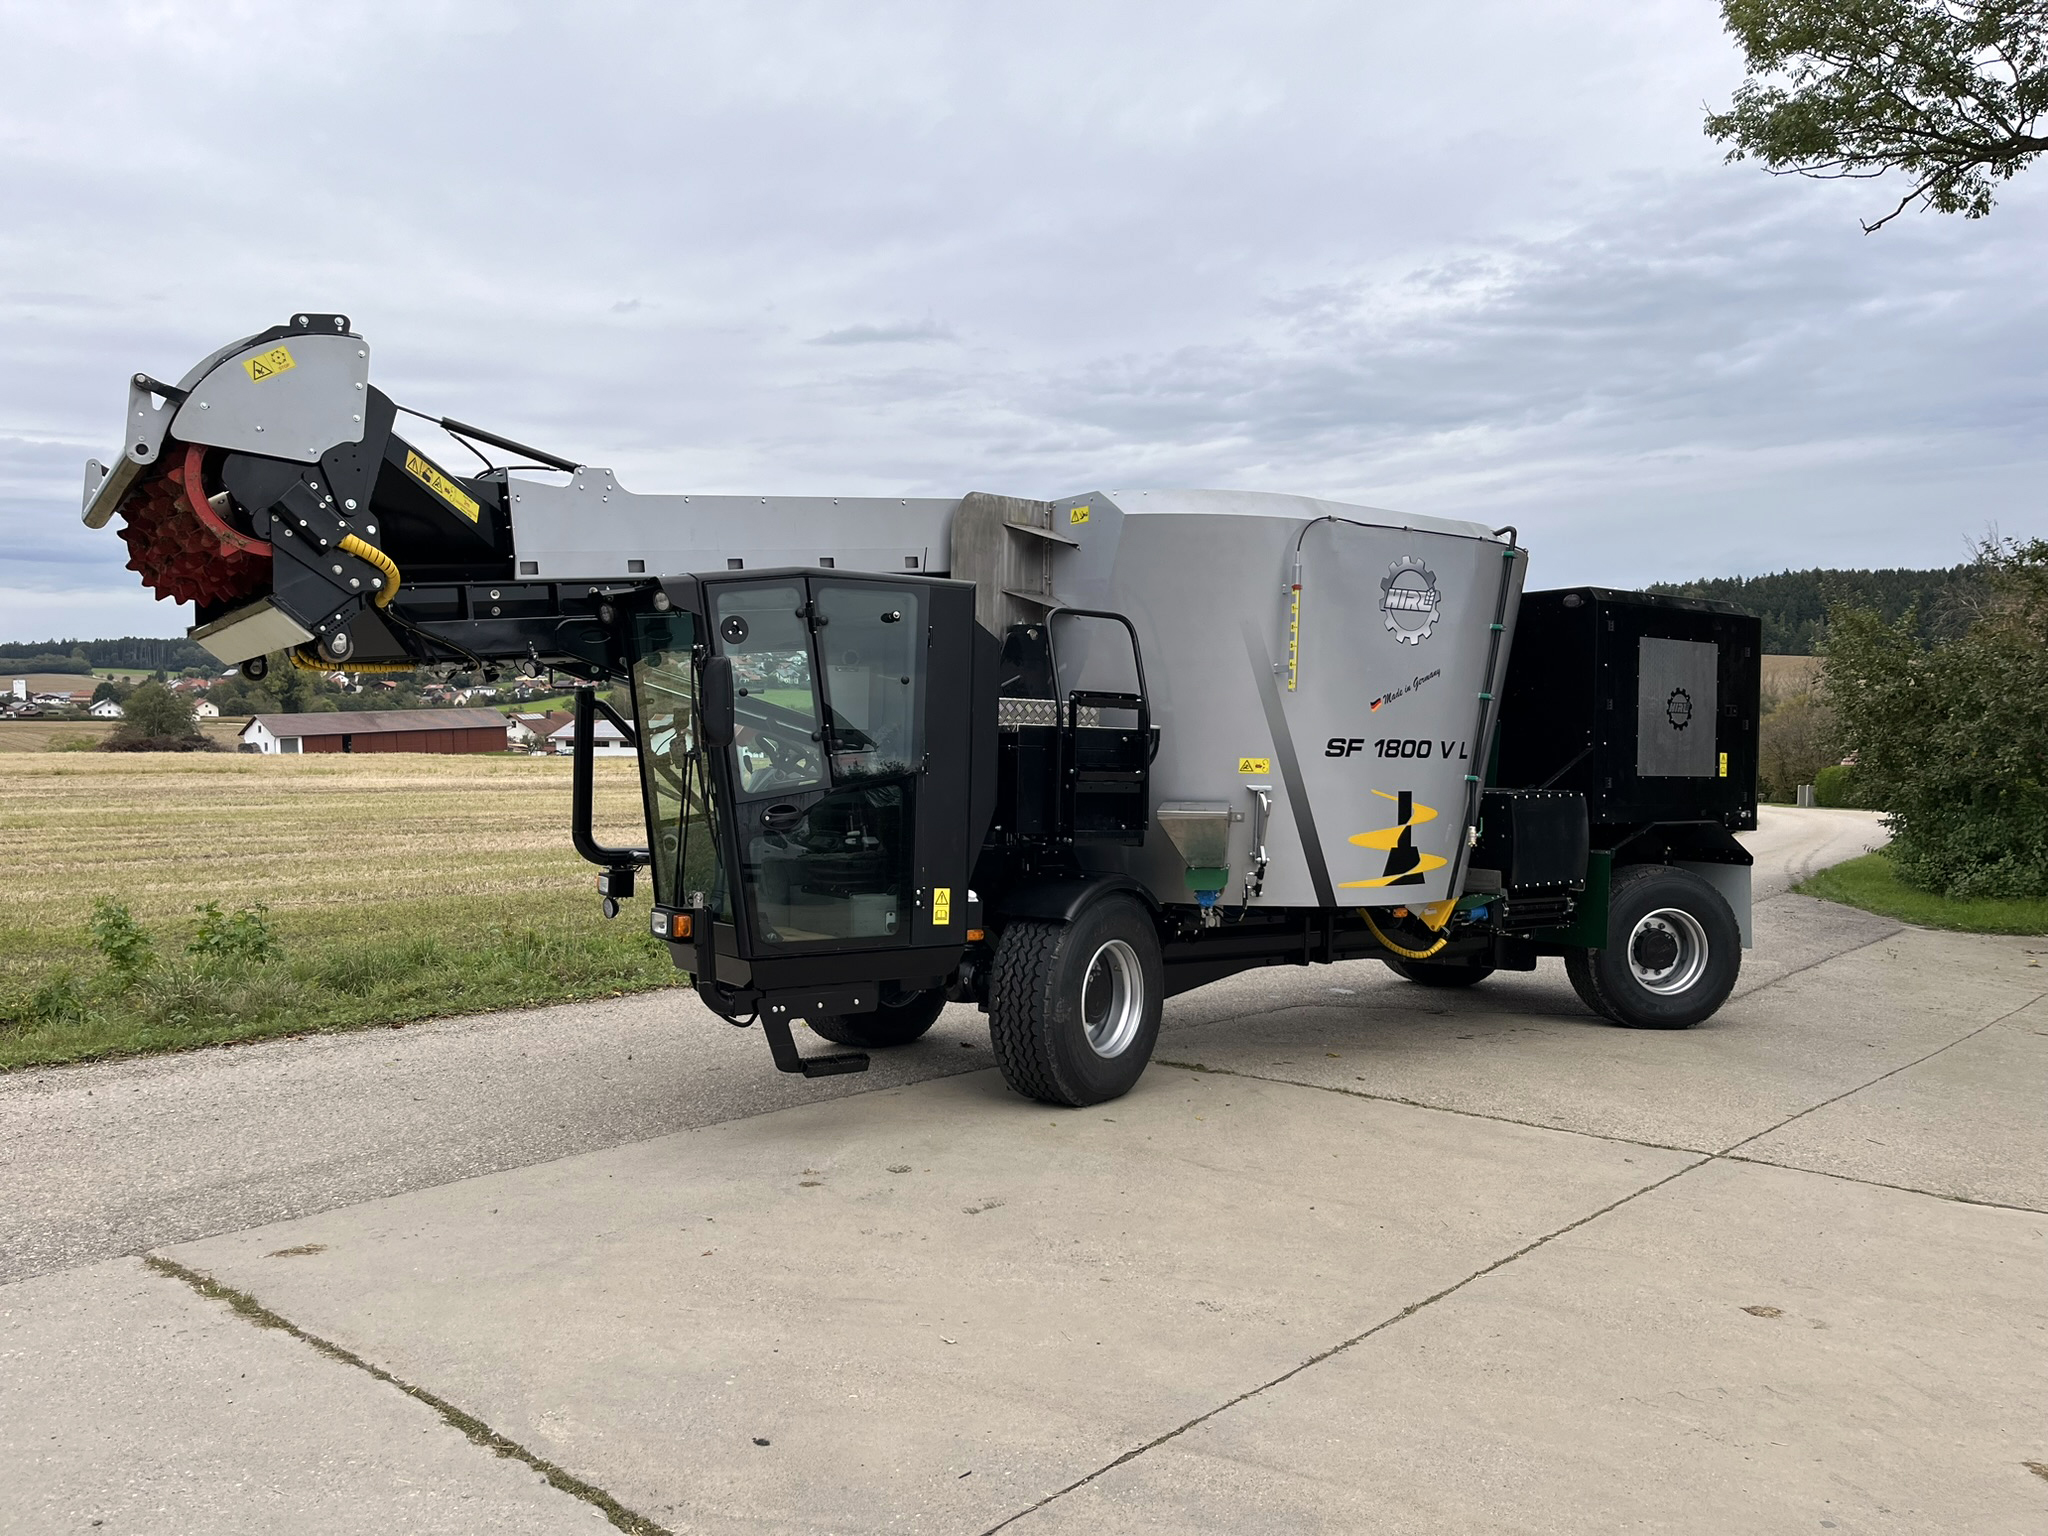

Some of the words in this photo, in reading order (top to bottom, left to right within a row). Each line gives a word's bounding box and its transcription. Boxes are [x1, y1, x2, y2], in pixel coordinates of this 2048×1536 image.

[1384, 587, 1434, 613] HIRL
[1382, 688, 1403, 705] Made
[1404, 684, 1411, 693] in
[1412, 668, 1441, 692] Germany
[1325, 738, 1365, 758] SF
[1374, 738, 1432, 759] 1800
